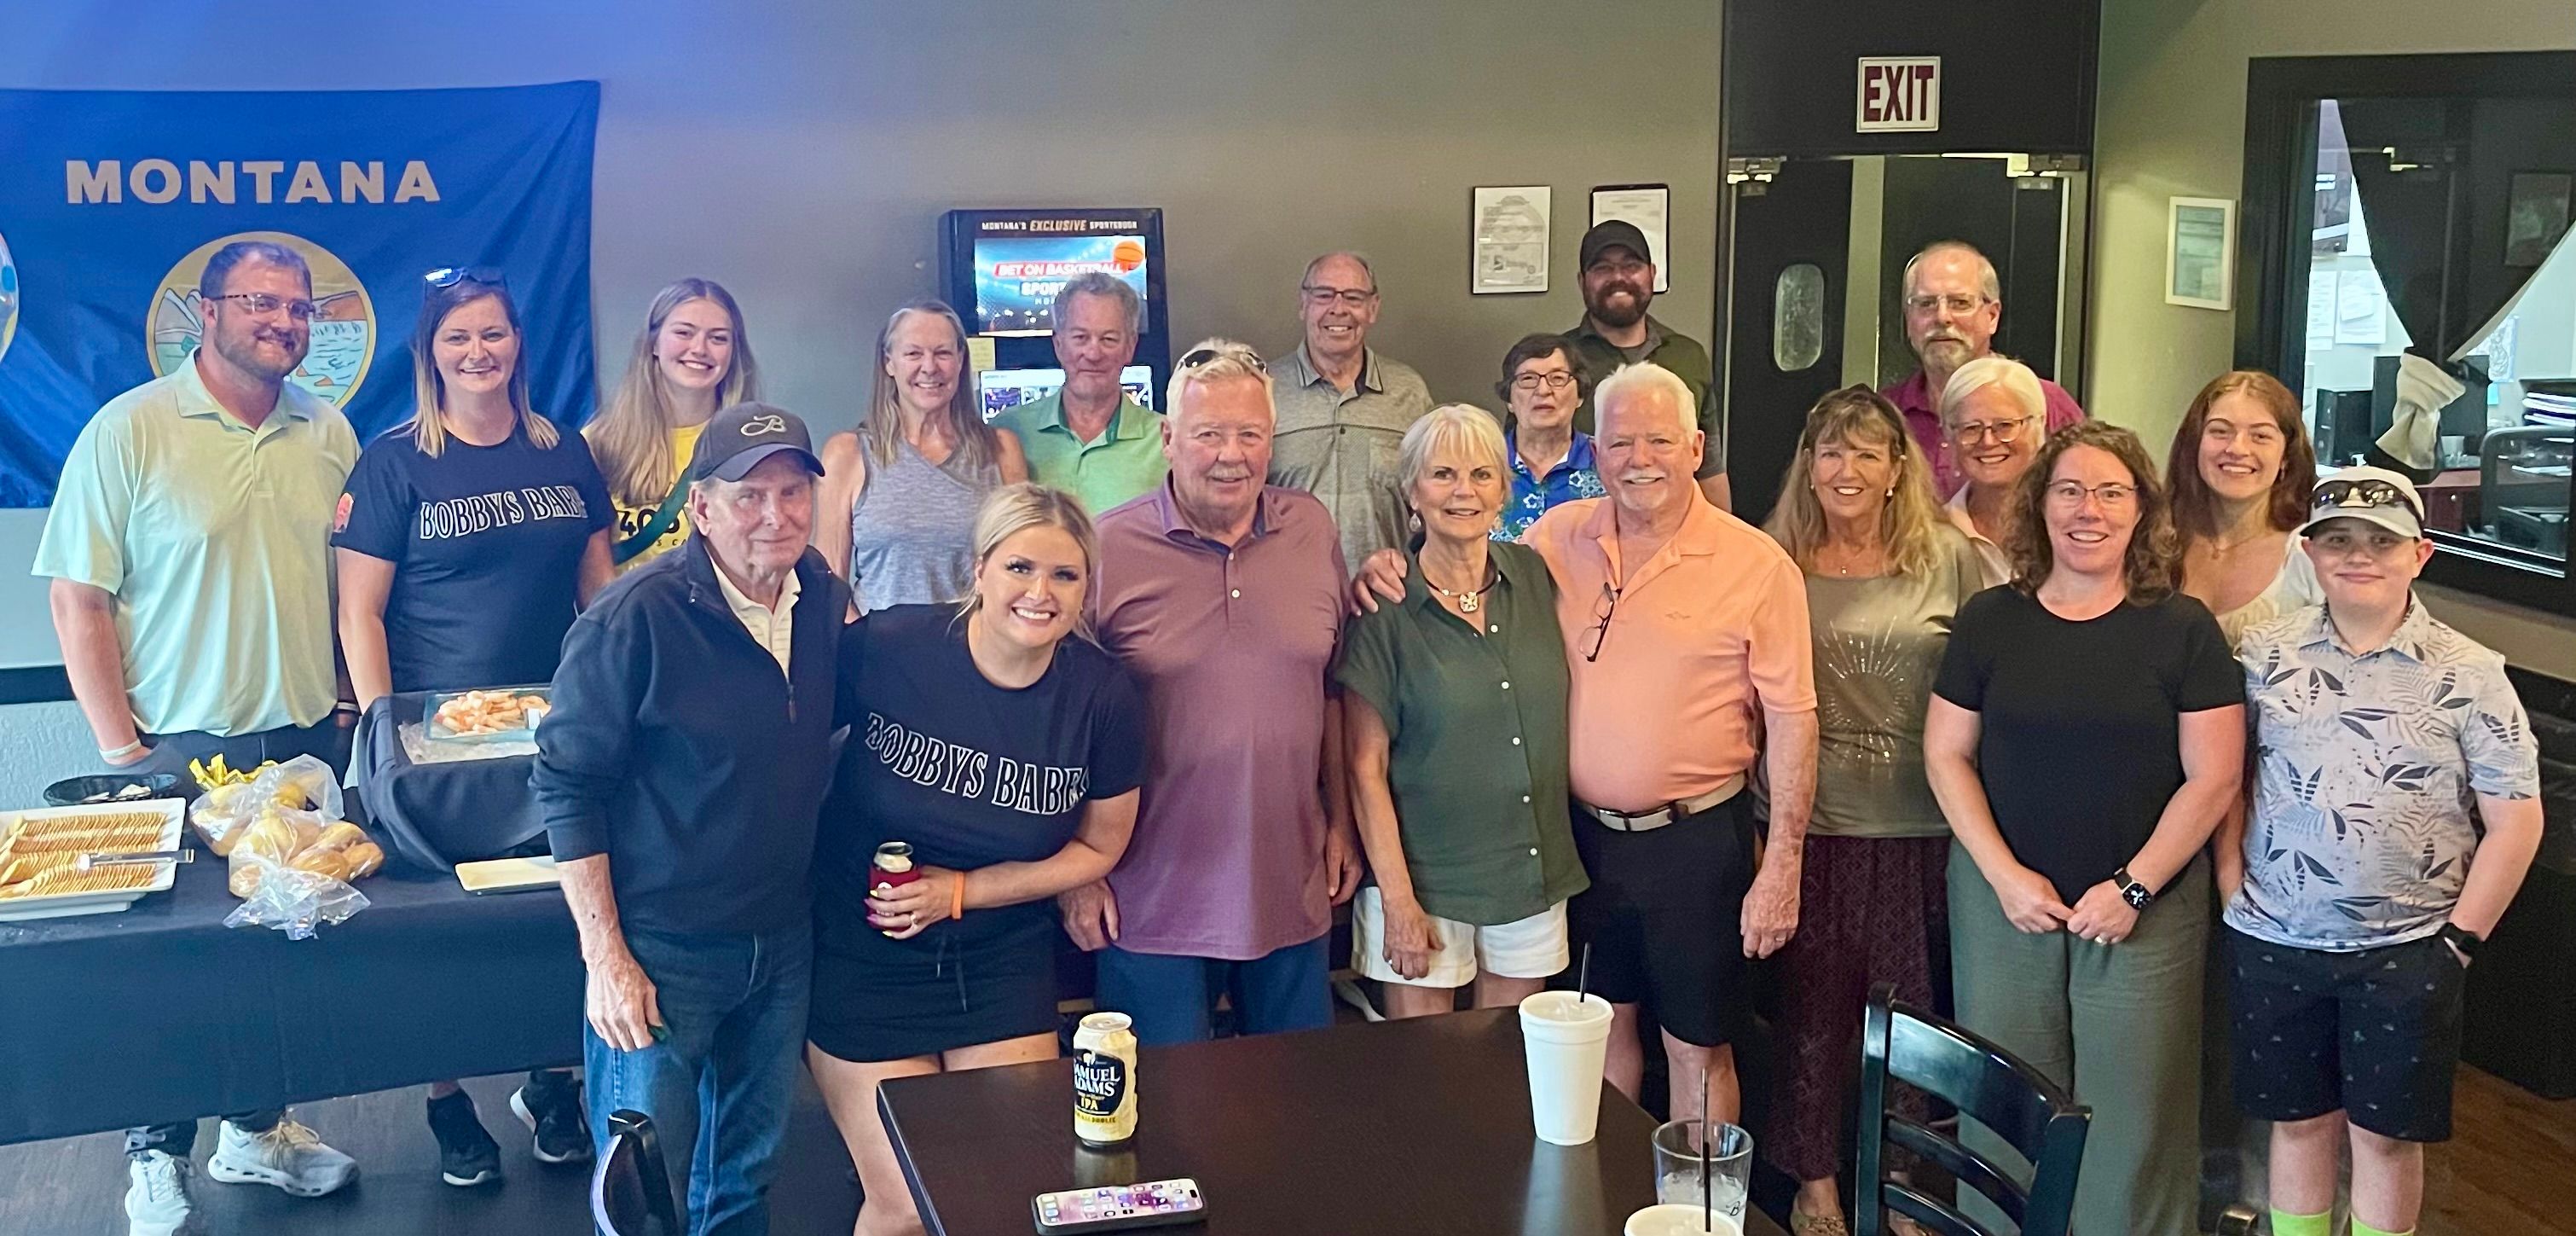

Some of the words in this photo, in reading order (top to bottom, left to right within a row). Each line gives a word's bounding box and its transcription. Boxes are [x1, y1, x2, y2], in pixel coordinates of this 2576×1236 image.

[1863, 65, 1934, 122] EXIT
[66, 159, 441, 205] MONTANA
[1029, 219, 1087, 232] EXCLUSIVE
[1089, 221, 1137, 229] SPORTSBOOK
[999, 264, 1022, 276] BET
[1024, 264, 1045, 276] ON
[1046, 263, 1124, 276] BASKETBALL
[420, 491, 524, 539] BOBBYS
[865, 712, 988, 798] BOBBYS
[1080, 1096, 1098, 1111] IPA
